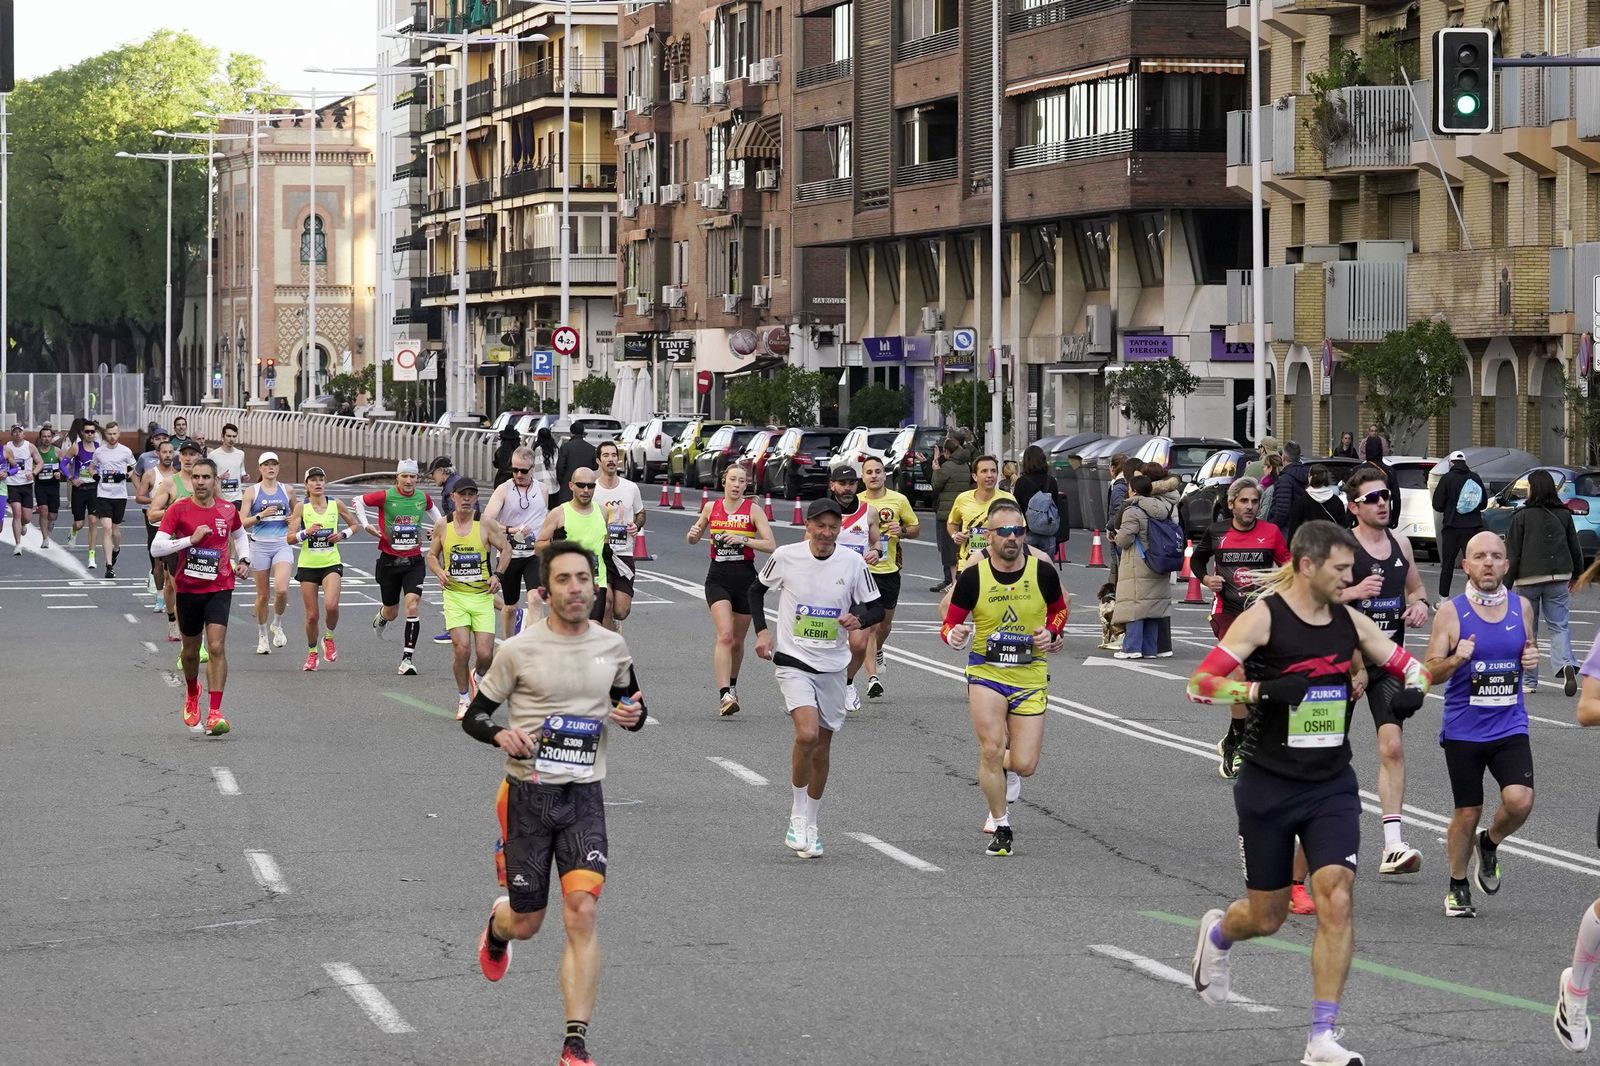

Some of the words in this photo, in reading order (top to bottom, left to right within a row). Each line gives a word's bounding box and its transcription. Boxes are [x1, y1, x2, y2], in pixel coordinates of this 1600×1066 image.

[659, 341, 690, 349] TINTE
[667, 349, 686, 362] 5€
[535, 354, 547, 370] P
[711, 520, 747, 529] SERPENTINE
[1222, 552, 1264, 563] ISBILYA
[187, 562, 217, 573] HUGONOE
[989, 594, 1009, 603] GPDM
[1373, 600, 1396, 608] ZURICH
[811, 608, 837, 617] ZURICH
[811, 620, 824, 628] 3331
[804, 628, 829, 639] KEBIR
[1003, 634, 1029, 642] ZURICH
[999, 653, 1018, 663] TANI
[1488, 662, 1516, 670] ZURICH
[1489, 676, 1505, 684] 5075
[1310, 689, 1342, 699] ZURICH
[1478, 685, 1514, 695] ANDONI
[1312, 708, 1329, 717] 2931
[566, 720, 599, 731] ZURICH
[1303, 720, 1336, 733] OSHRI
[563, 737, 584, 748] 5309
